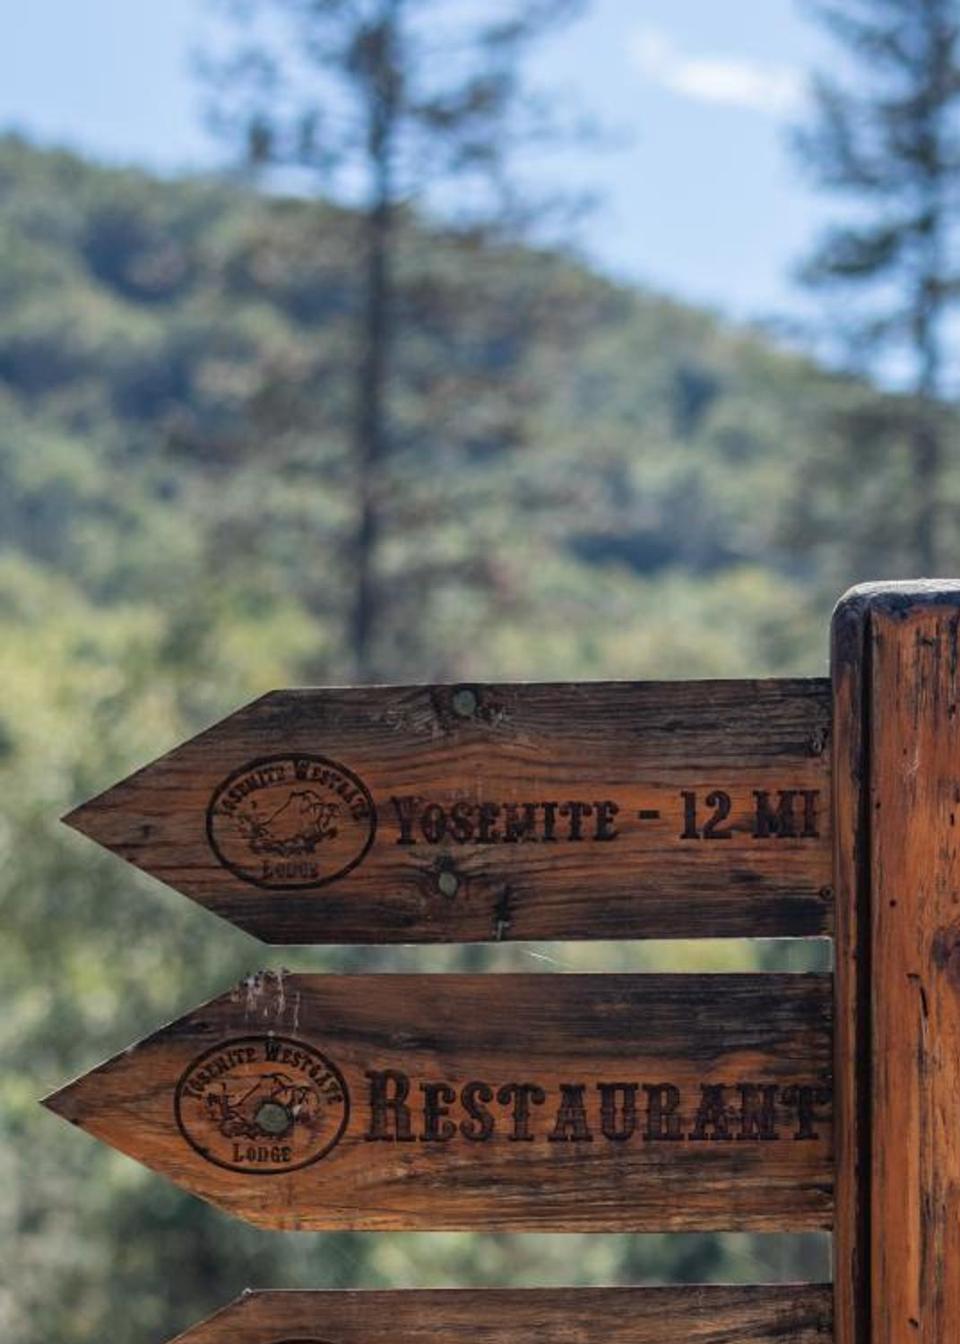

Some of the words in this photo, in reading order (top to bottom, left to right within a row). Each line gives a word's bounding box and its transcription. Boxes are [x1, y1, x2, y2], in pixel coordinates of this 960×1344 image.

[391, 793, 619, 845] YOSEMITE
[680, 790, 732, 839] 12
[752, 790, 820, 838] MI
[364, 1068, 832, 1142] RESTAURANT
